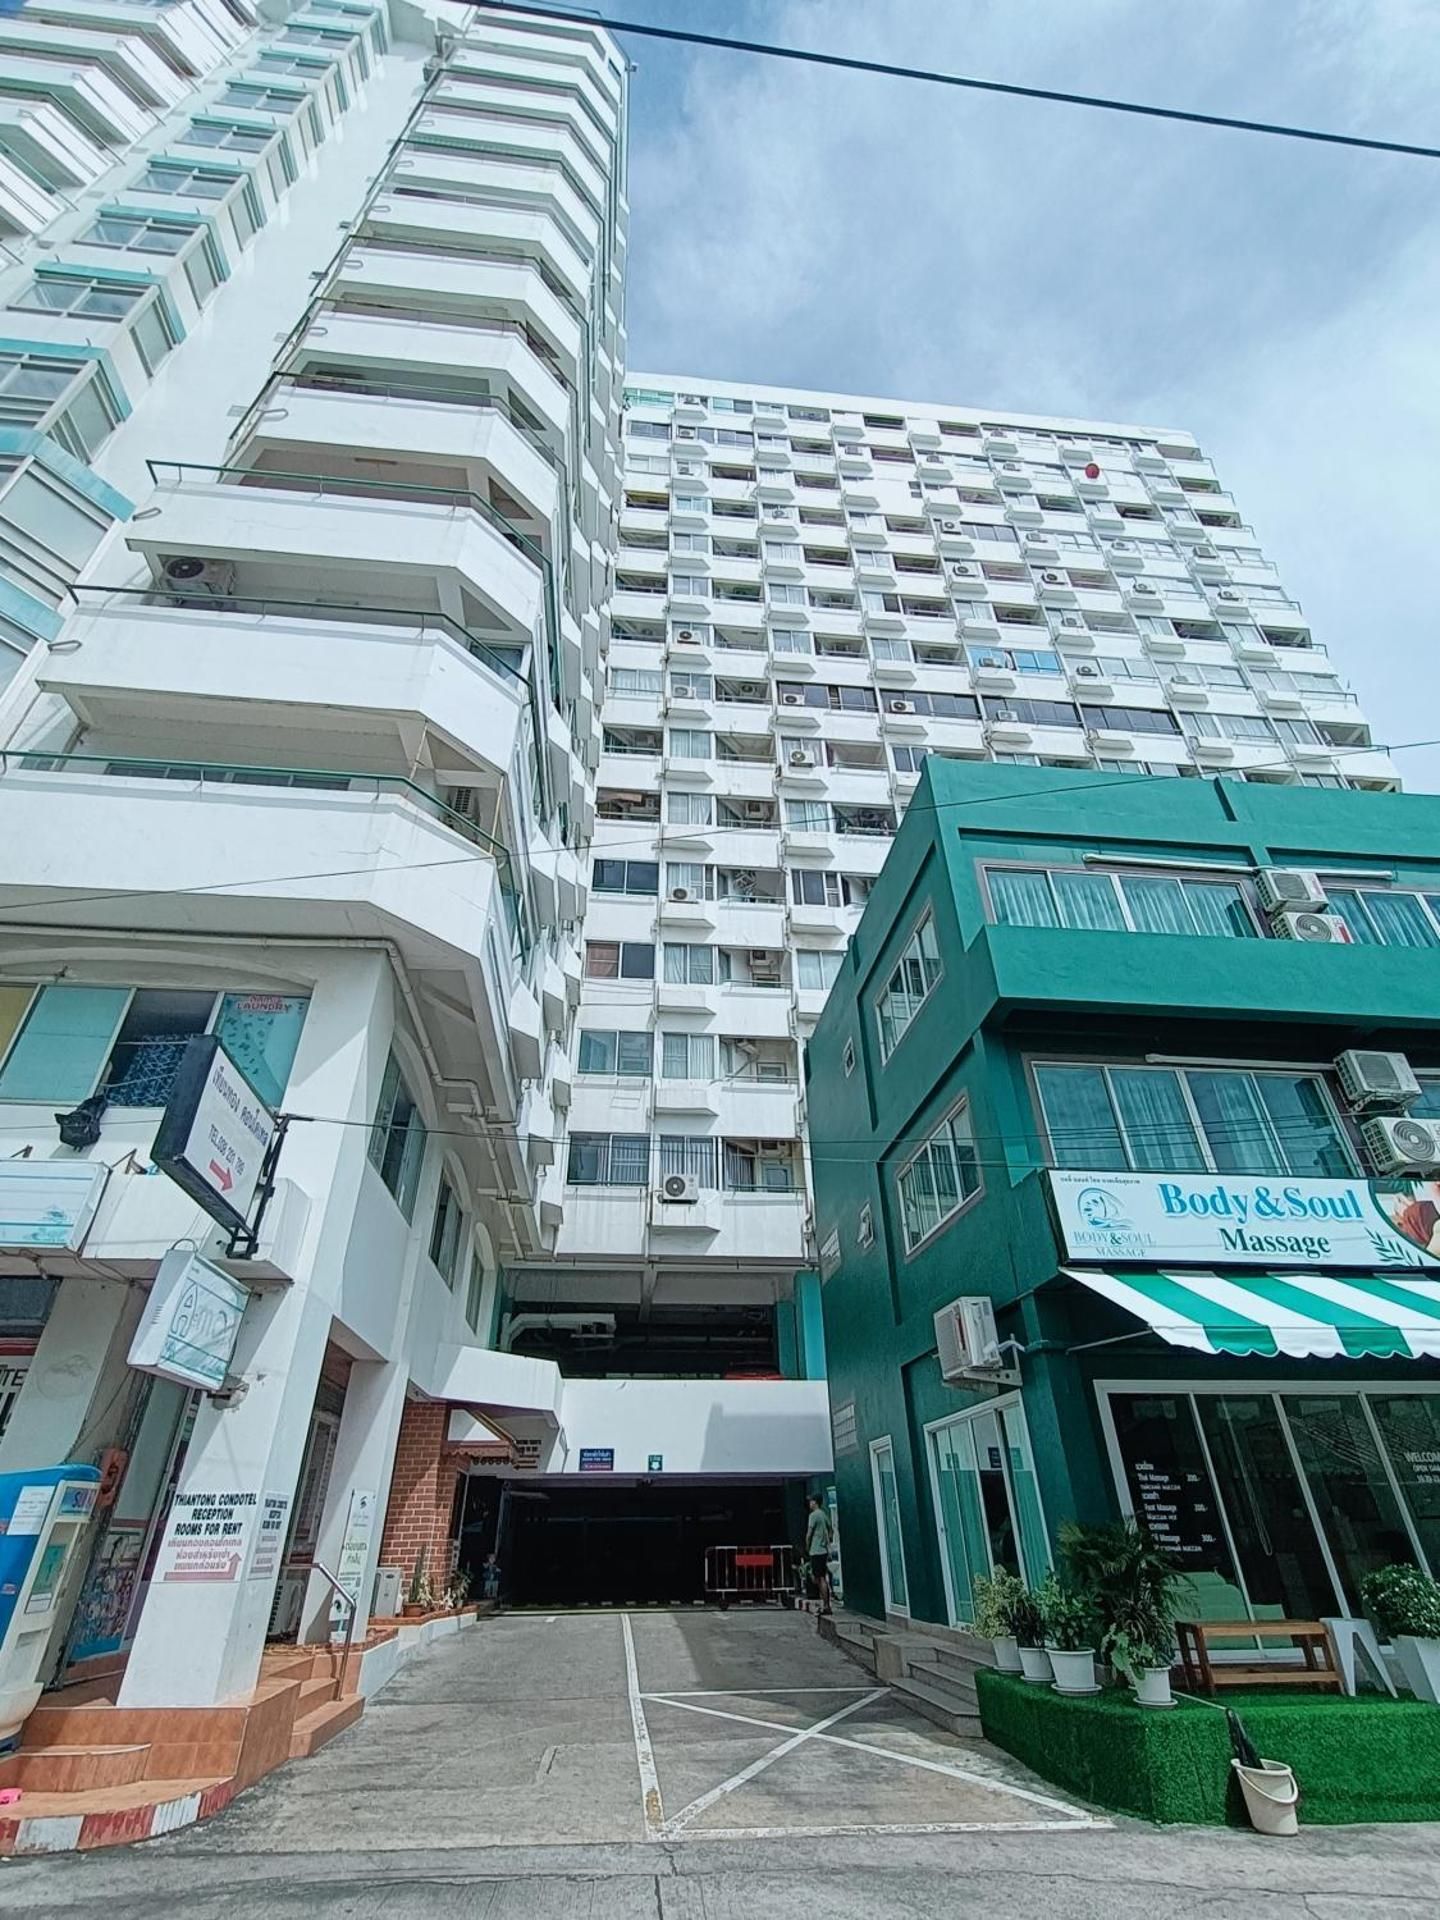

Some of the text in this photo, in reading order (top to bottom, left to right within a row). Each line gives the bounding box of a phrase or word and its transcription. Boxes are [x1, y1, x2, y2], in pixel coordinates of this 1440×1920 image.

[237, 1002, 291, 1012] LAUNDRY
[1219, 1227, 1332, 1260] Massage
[1096, 1247, 1146, 1257] MASSAGE
[174, 1493, 217, 1506] THIANTONG
[218, 1493, 257, 1506] CONDOTEL
[191, 1508, 234, 1520] RECEPTION
[174, 1522, 243, 1535] ROOMS FOR RENT
